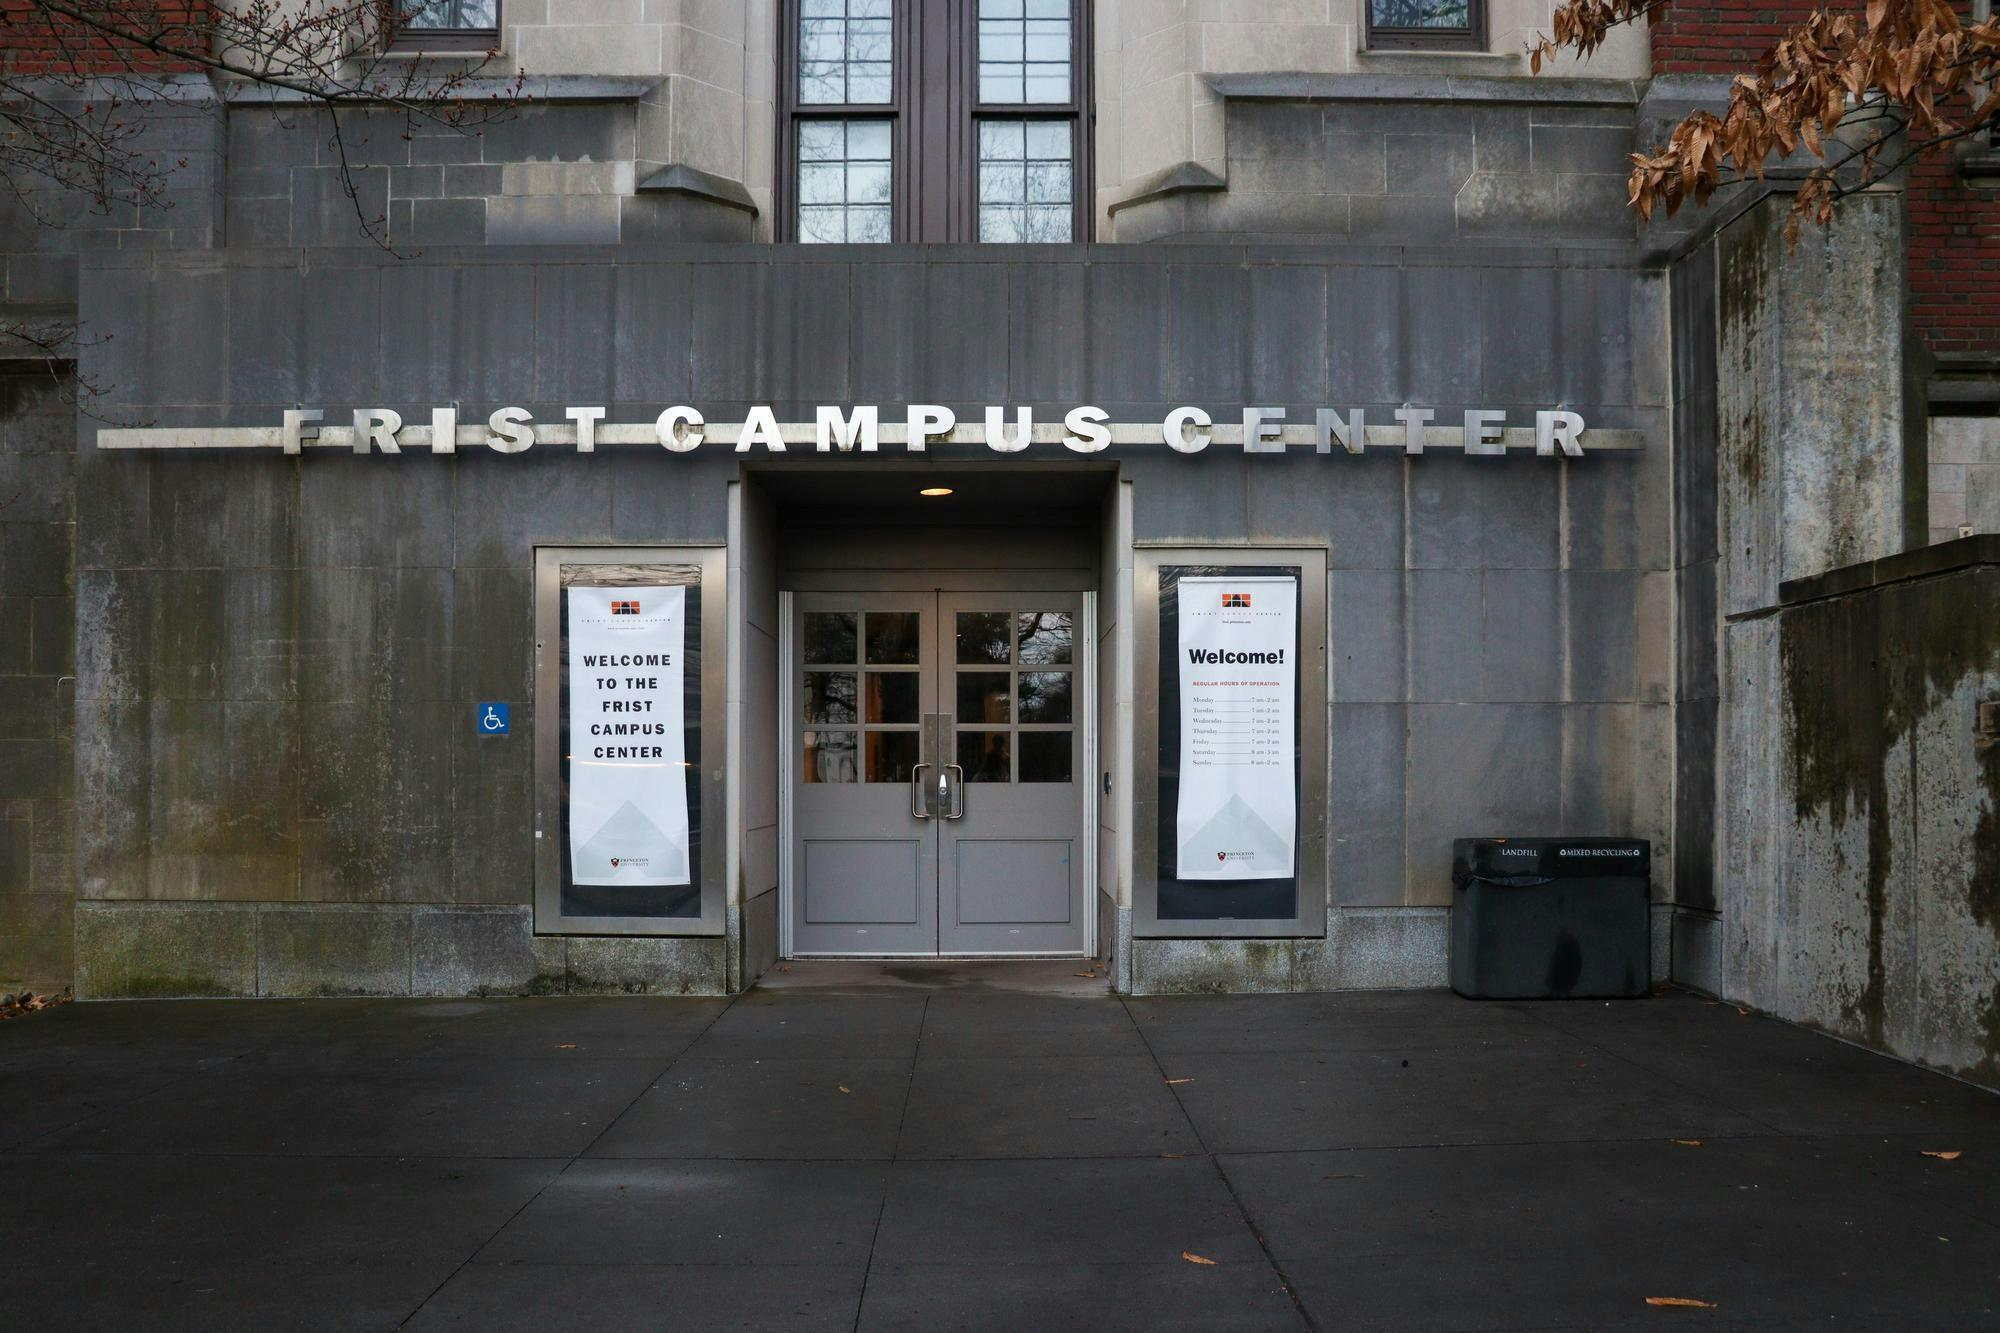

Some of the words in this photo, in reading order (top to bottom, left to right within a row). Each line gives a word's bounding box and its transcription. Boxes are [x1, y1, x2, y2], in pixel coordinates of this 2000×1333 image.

[283, 406, 605, 454] FRIST
[655, 405, 1112, 453] CAMPUS
[1162, 406, 1585, 456] CENTER
[583, 654, 671, 667] WELCOME
[1188, 648, 1284, 665] Welcome!
[596, 678, 617, 689] TO
[625, 677, 657, 689] THE
[602, 700, 652, 712] FRIST
[591, 723, 665, 735] CAMPUS
[594, 746, 662, 758] CENTER
[1502, 849, 1538, 857] LANDFILL
